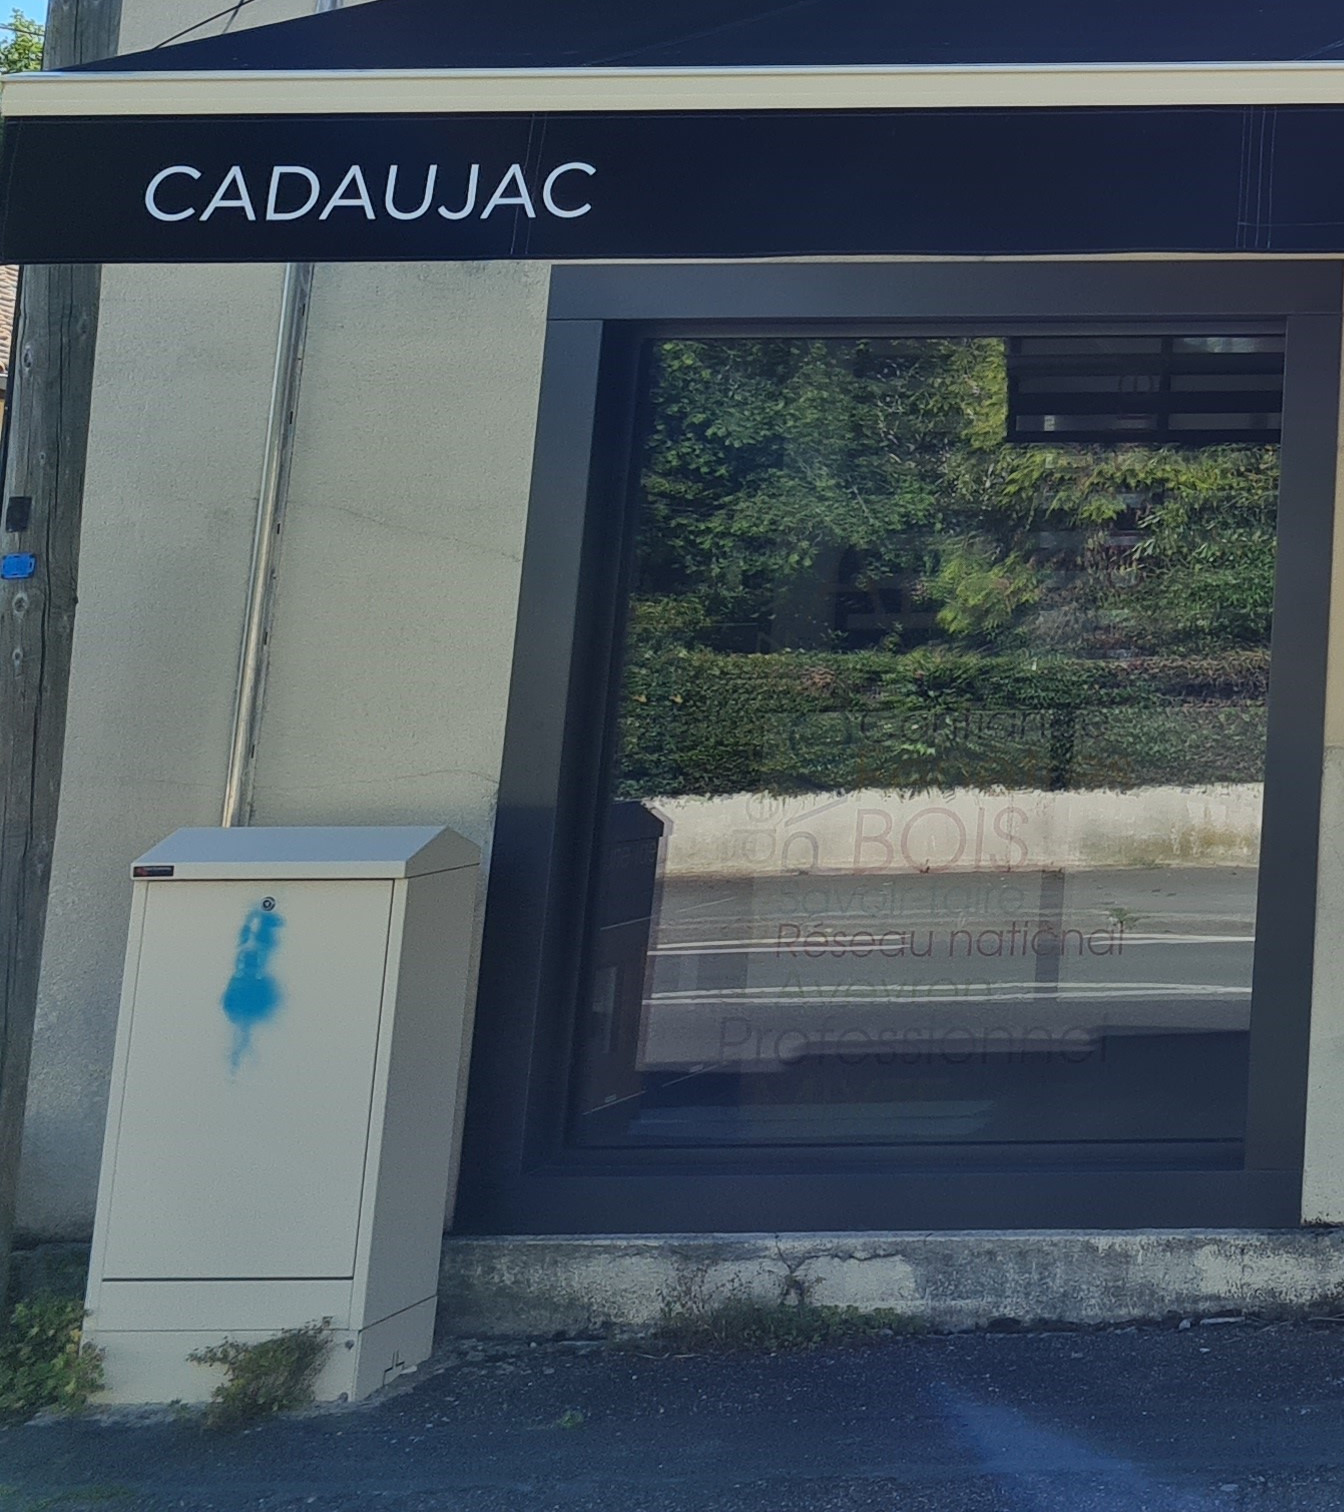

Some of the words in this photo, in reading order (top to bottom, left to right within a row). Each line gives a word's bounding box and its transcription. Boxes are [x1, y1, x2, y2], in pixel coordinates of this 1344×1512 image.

[145, 162, 596, 221] CADAUJAC
[775, 922, 934, 958] Réseau
[947, 922, 1126, 957] national
